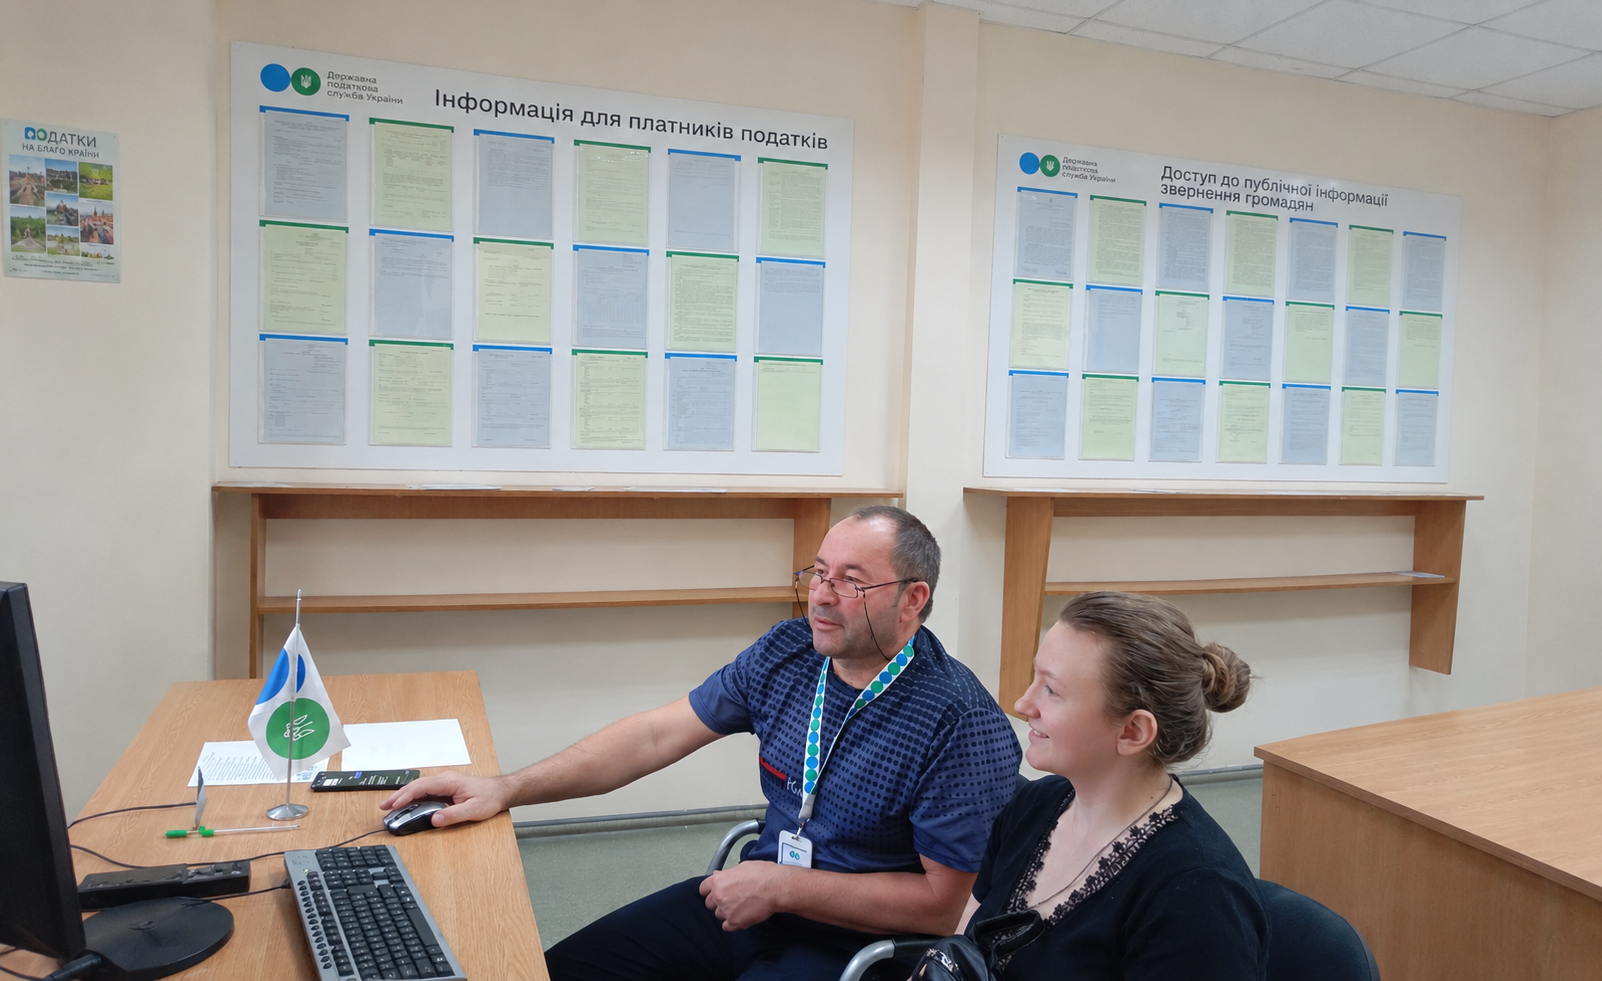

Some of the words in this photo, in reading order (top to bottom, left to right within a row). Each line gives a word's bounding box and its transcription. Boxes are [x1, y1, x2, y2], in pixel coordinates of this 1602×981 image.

[326, 70, 377, 84] Державна
[326, 81, 379, 93] податкова
[326, 90, 364, 100] служба
[434, 88, 574, 123] Інформація
[580, 110, 621, 127] для
[629, 116, 734, 139] платників
[741, 128, 828, 150] податків
[24, 126, 97, 148] ПОДАТКИ
[22, 143, 34, 151] НА
[37, 144, 66, 155] БЛАГО
[1161, 165, 1217, 187] Доступ
[1220, 174, 1240, 188] до
[1244, 178, 1313, 197] публічної
[1316, 184, 1389, 207] інформації
[1160, 183, 1241, 202] звернення
[1245, 194, 1314, 212] громадян
